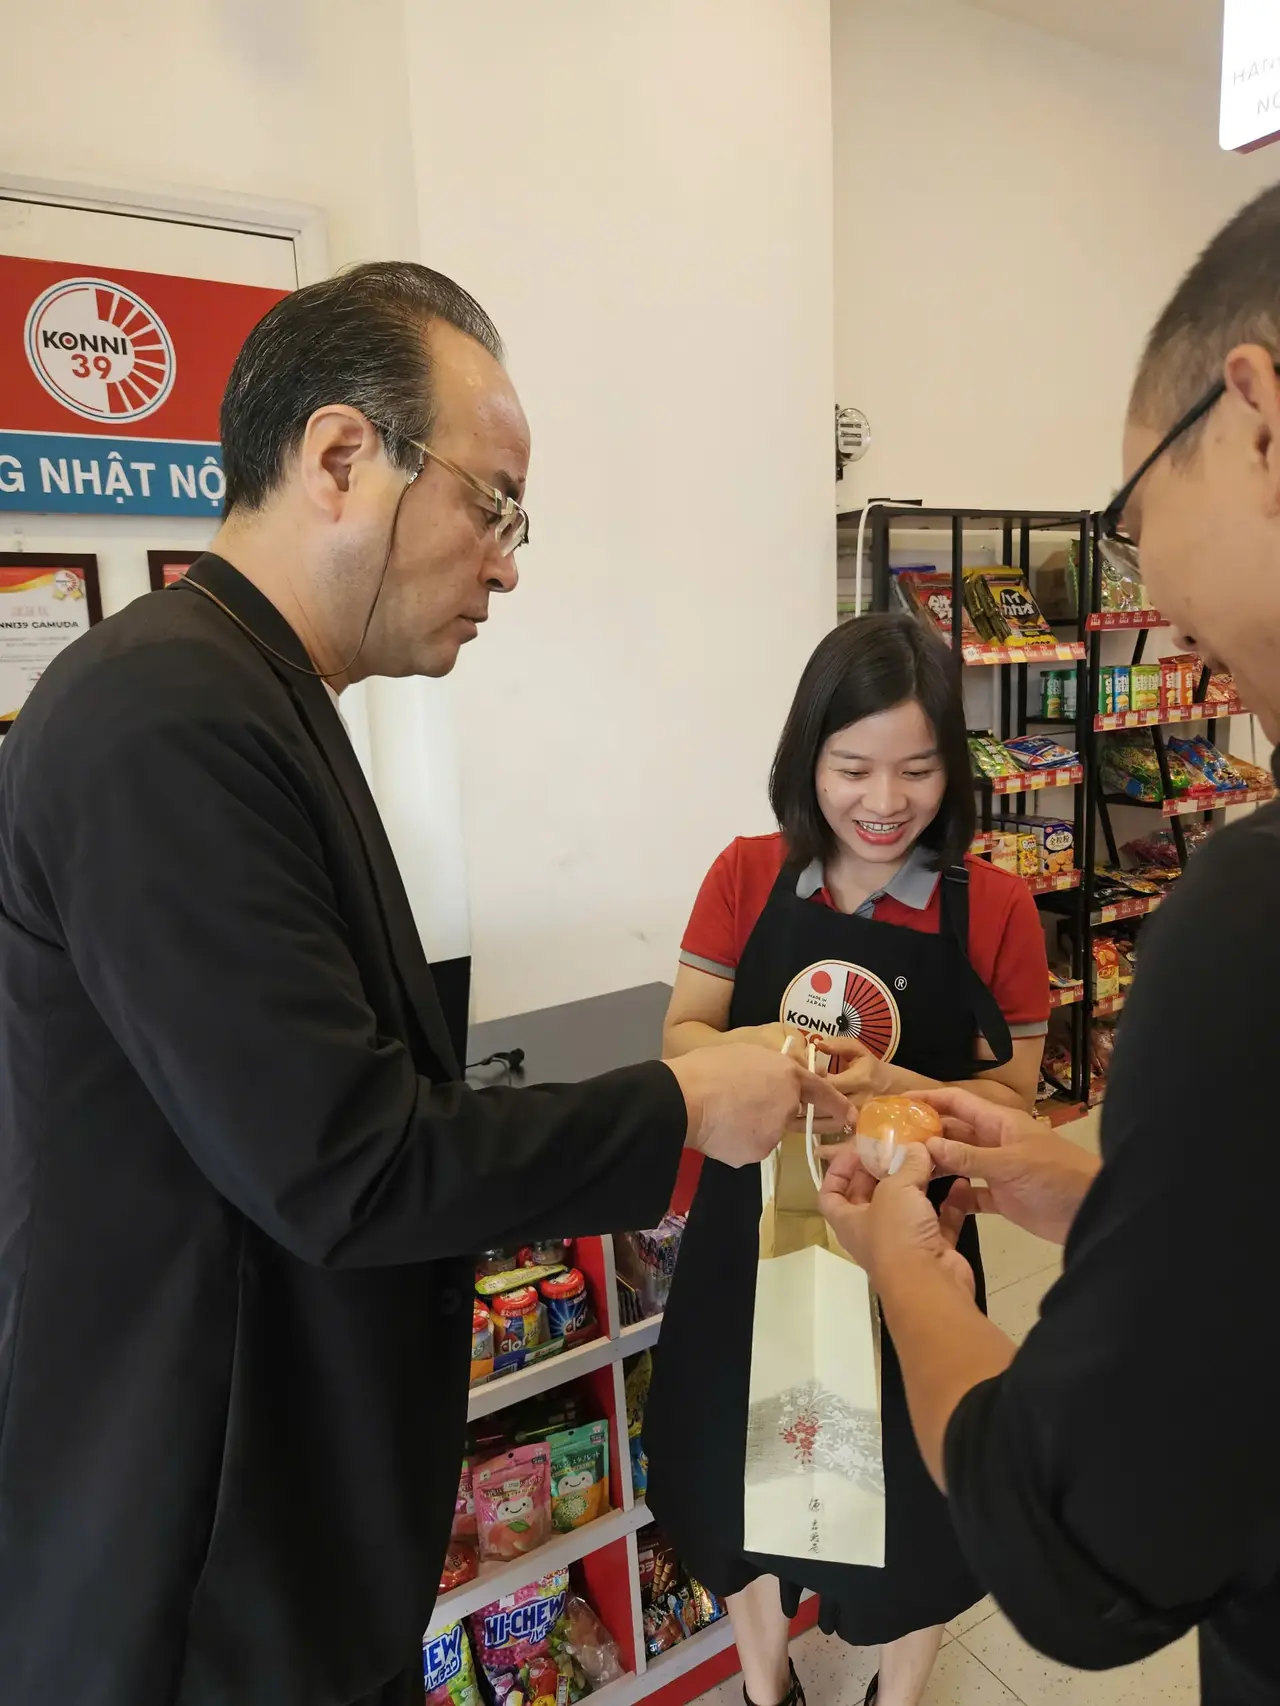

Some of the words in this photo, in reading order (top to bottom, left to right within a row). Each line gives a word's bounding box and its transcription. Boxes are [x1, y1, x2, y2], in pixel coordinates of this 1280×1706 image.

[42, 330, 128, 355] KONNI
[71, 354, 112, 380] 39
[0, 455, 25, 493] G
[39, 451, 156, 504] NHẬT
[806, 998, 826, 1008] JAPAN
[786, 1009, 836, 1036] KONNI
[484, 1590, 567, 1647] HI-CHEW
